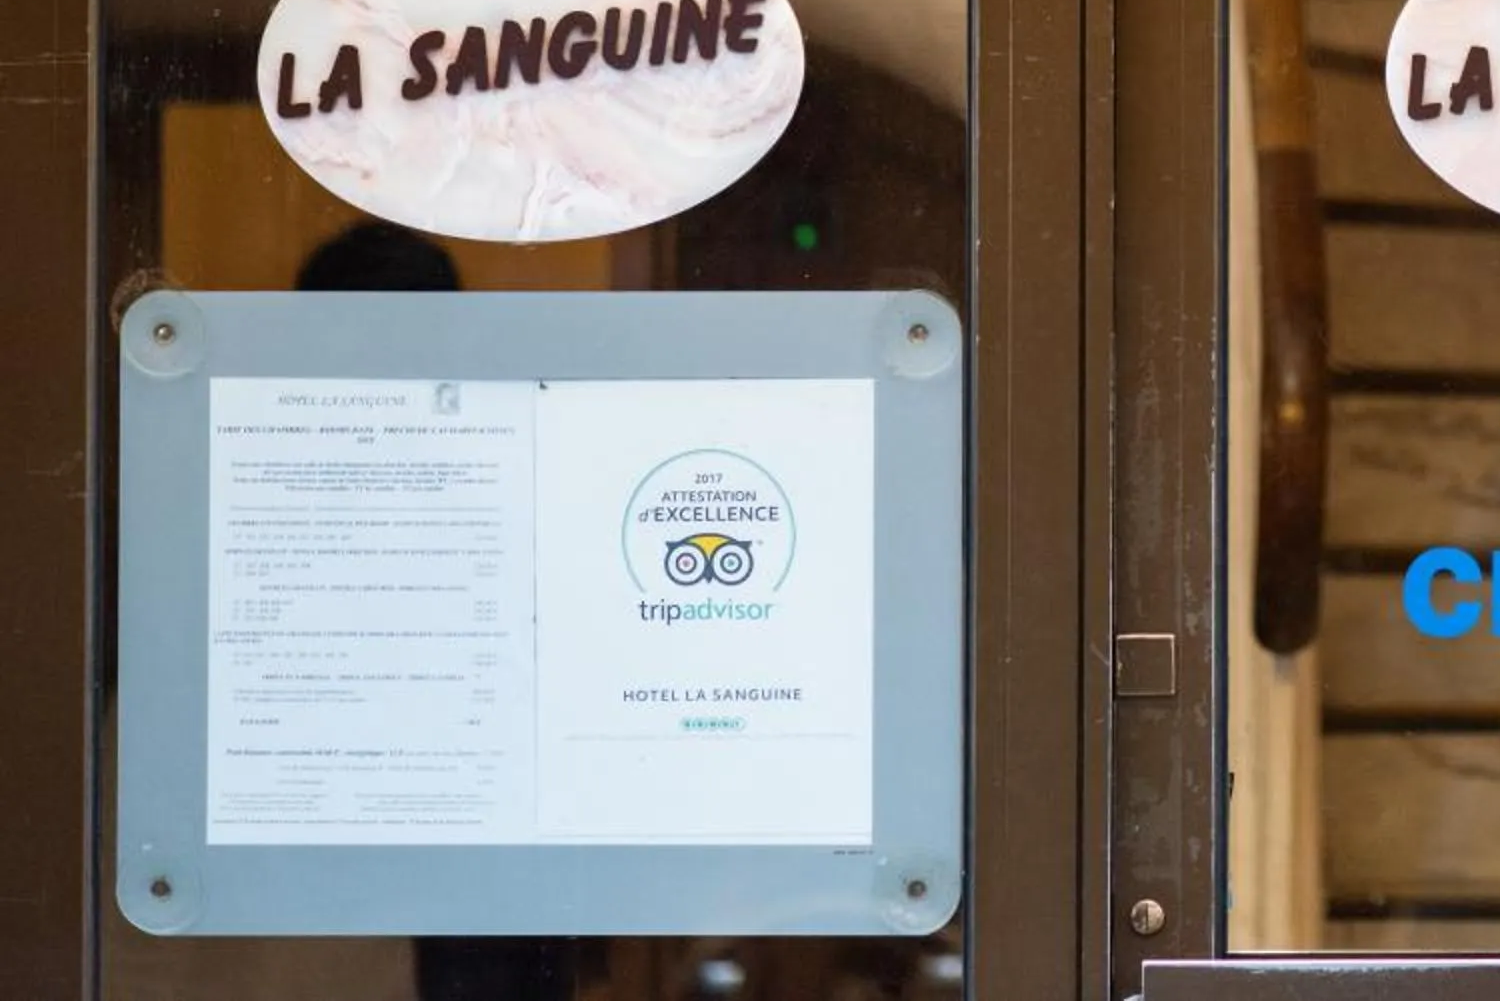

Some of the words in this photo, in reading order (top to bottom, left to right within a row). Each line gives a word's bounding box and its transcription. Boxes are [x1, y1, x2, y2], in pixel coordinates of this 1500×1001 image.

[277, 44, 363, 119] LA
[1407, 46, 1494, 122] LA
[694, 472, 723, 485] 2017
[661, 490, 757, 502] ATTESTATION
[638, 505, 780, 523] d'EXCELLENCE
[638, 597, 774, 626] tripadvisor
[623, 689, 680, 702] HOTEL
[685, 689, 707, 702] LA
[713, 688, 802, 702] SANGUINE
